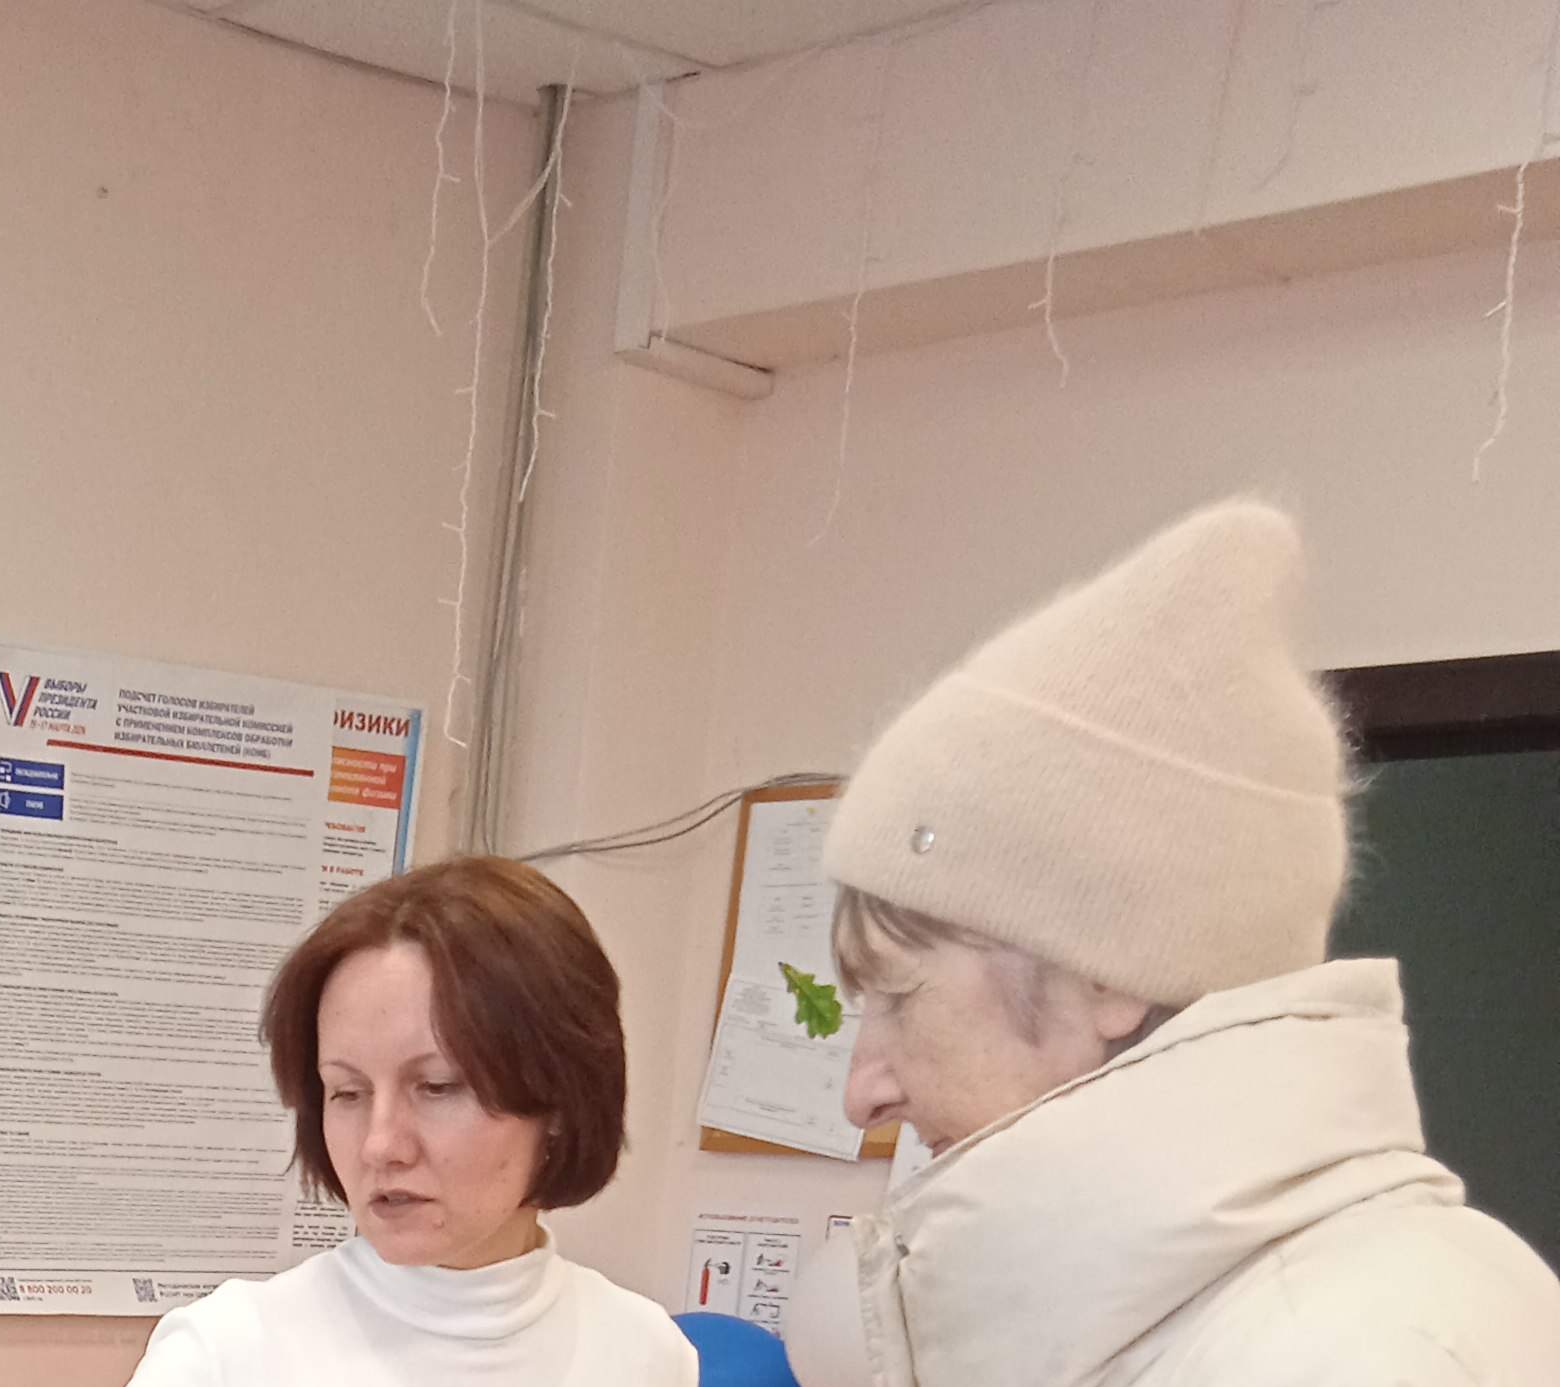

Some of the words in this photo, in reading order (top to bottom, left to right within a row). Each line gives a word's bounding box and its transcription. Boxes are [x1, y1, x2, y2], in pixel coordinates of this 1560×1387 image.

[44, 678, 88, 693] ВЫБОРЫ
[38, 692, 98, 710] ПРЕЗИДЕНТА
[33, 706, 71, 720] РОССИИ
